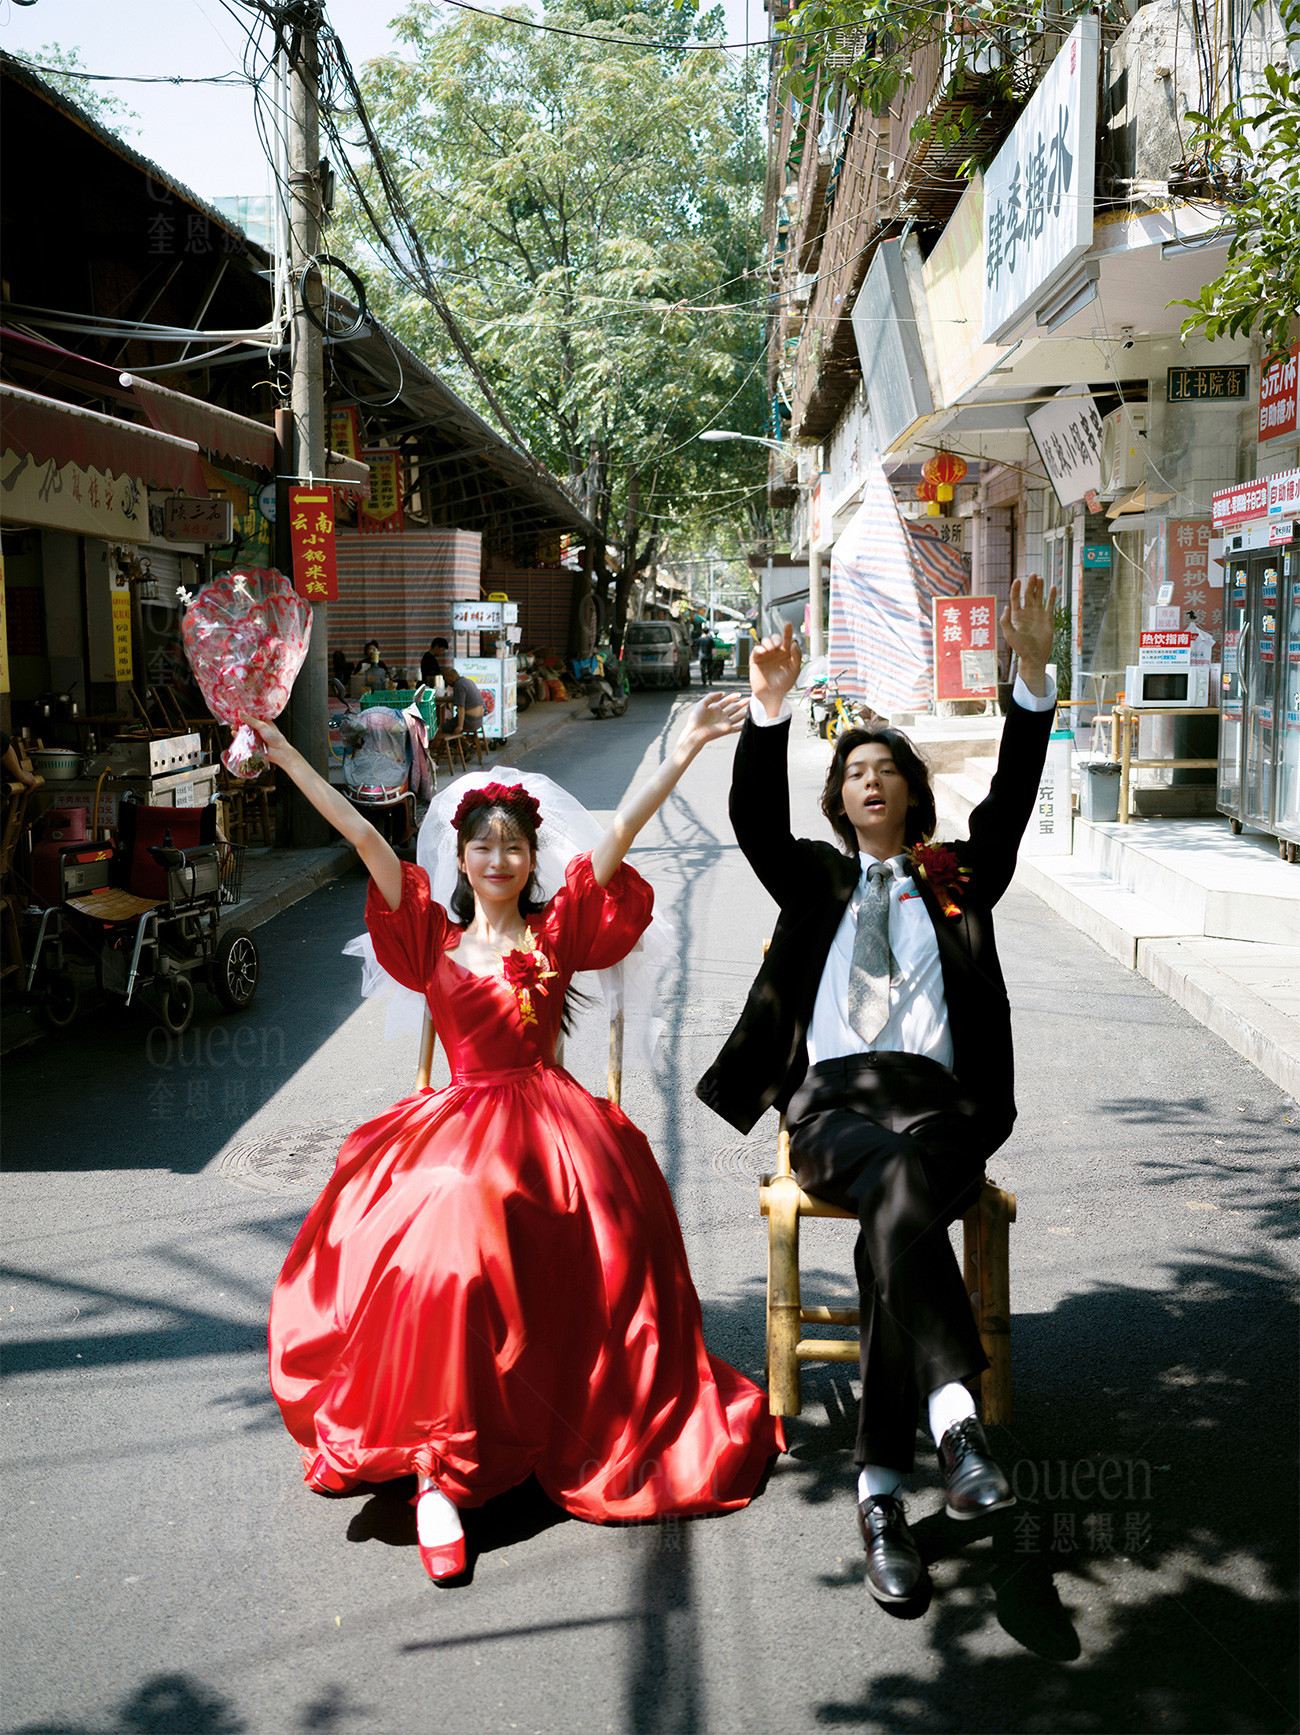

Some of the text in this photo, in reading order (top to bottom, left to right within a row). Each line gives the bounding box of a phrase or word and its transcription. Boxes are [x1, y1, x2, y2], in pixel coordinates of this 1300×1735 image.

[1176, 371, 1241, 397] 北书院街
[1260, 395, 1295, 431] 自助糖水
[292, 512, 333, 534] 云南
[940, 523, 962, 544] 诊所
[301, 533, 329, 595] 小锅米线
[1142, 633, 1189, 645] 热饮指南
[1039, 786, 1054, 834] 充电宝
